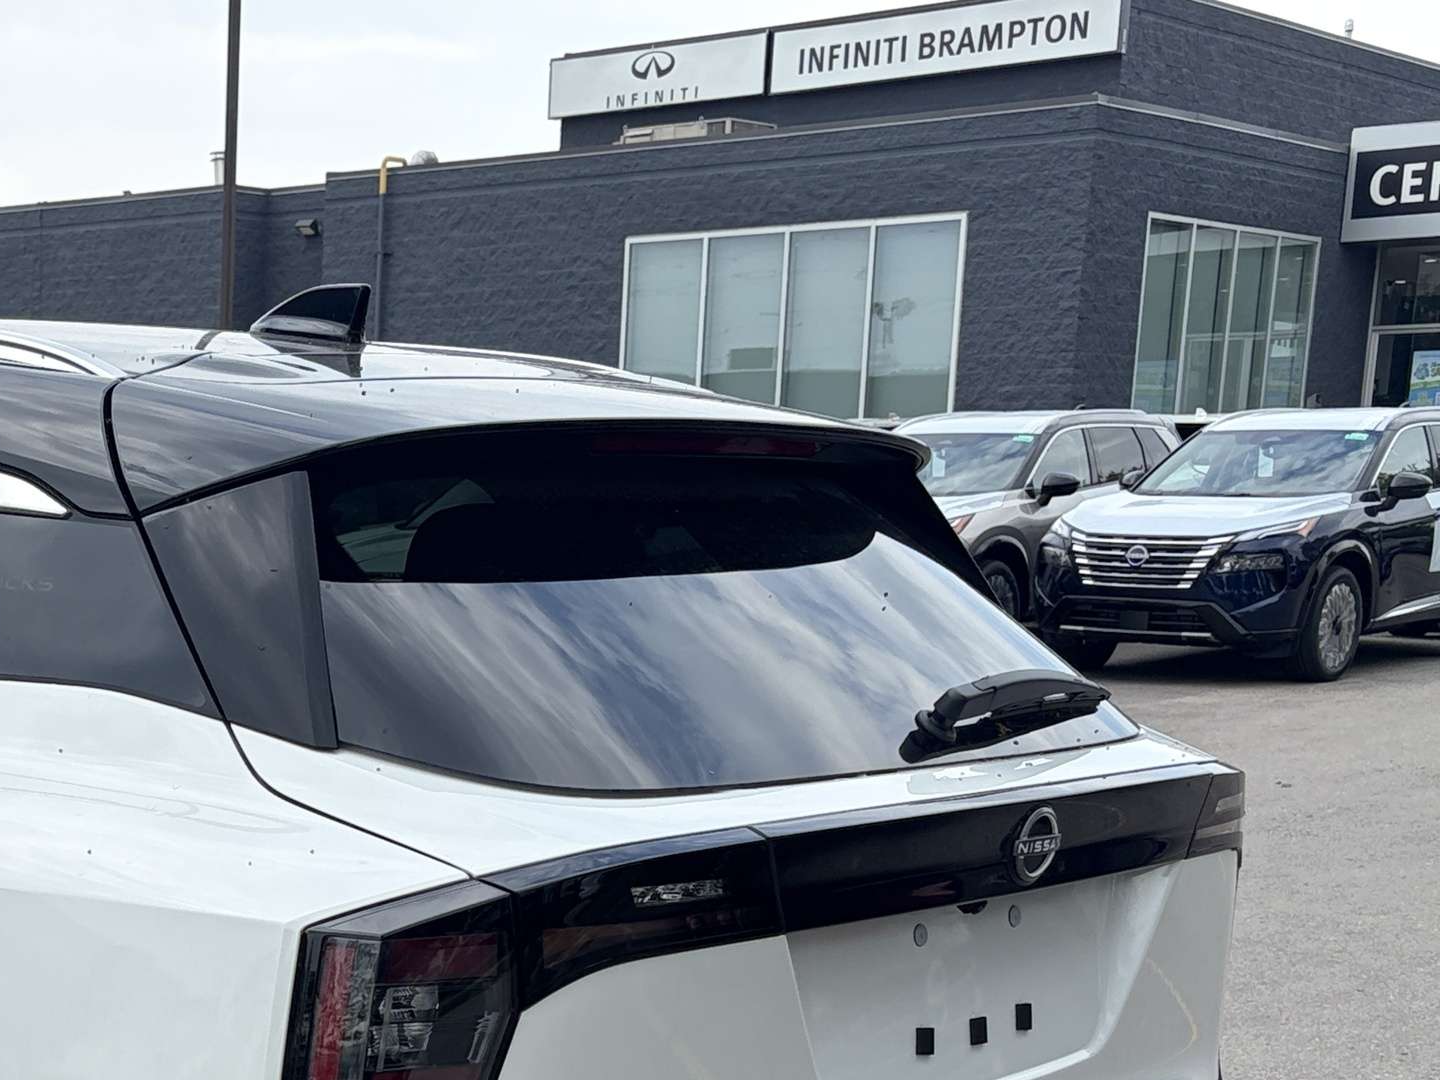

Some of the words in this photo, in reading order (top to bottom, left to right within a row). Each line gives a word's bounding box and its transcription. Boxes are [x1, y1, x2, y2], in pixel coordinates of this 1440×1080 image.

[798, 35, 908, 75] INFINITI
[918, 11, 1090, 60] BRAMPTON
[606, 86, 699, 109] INFINITI
